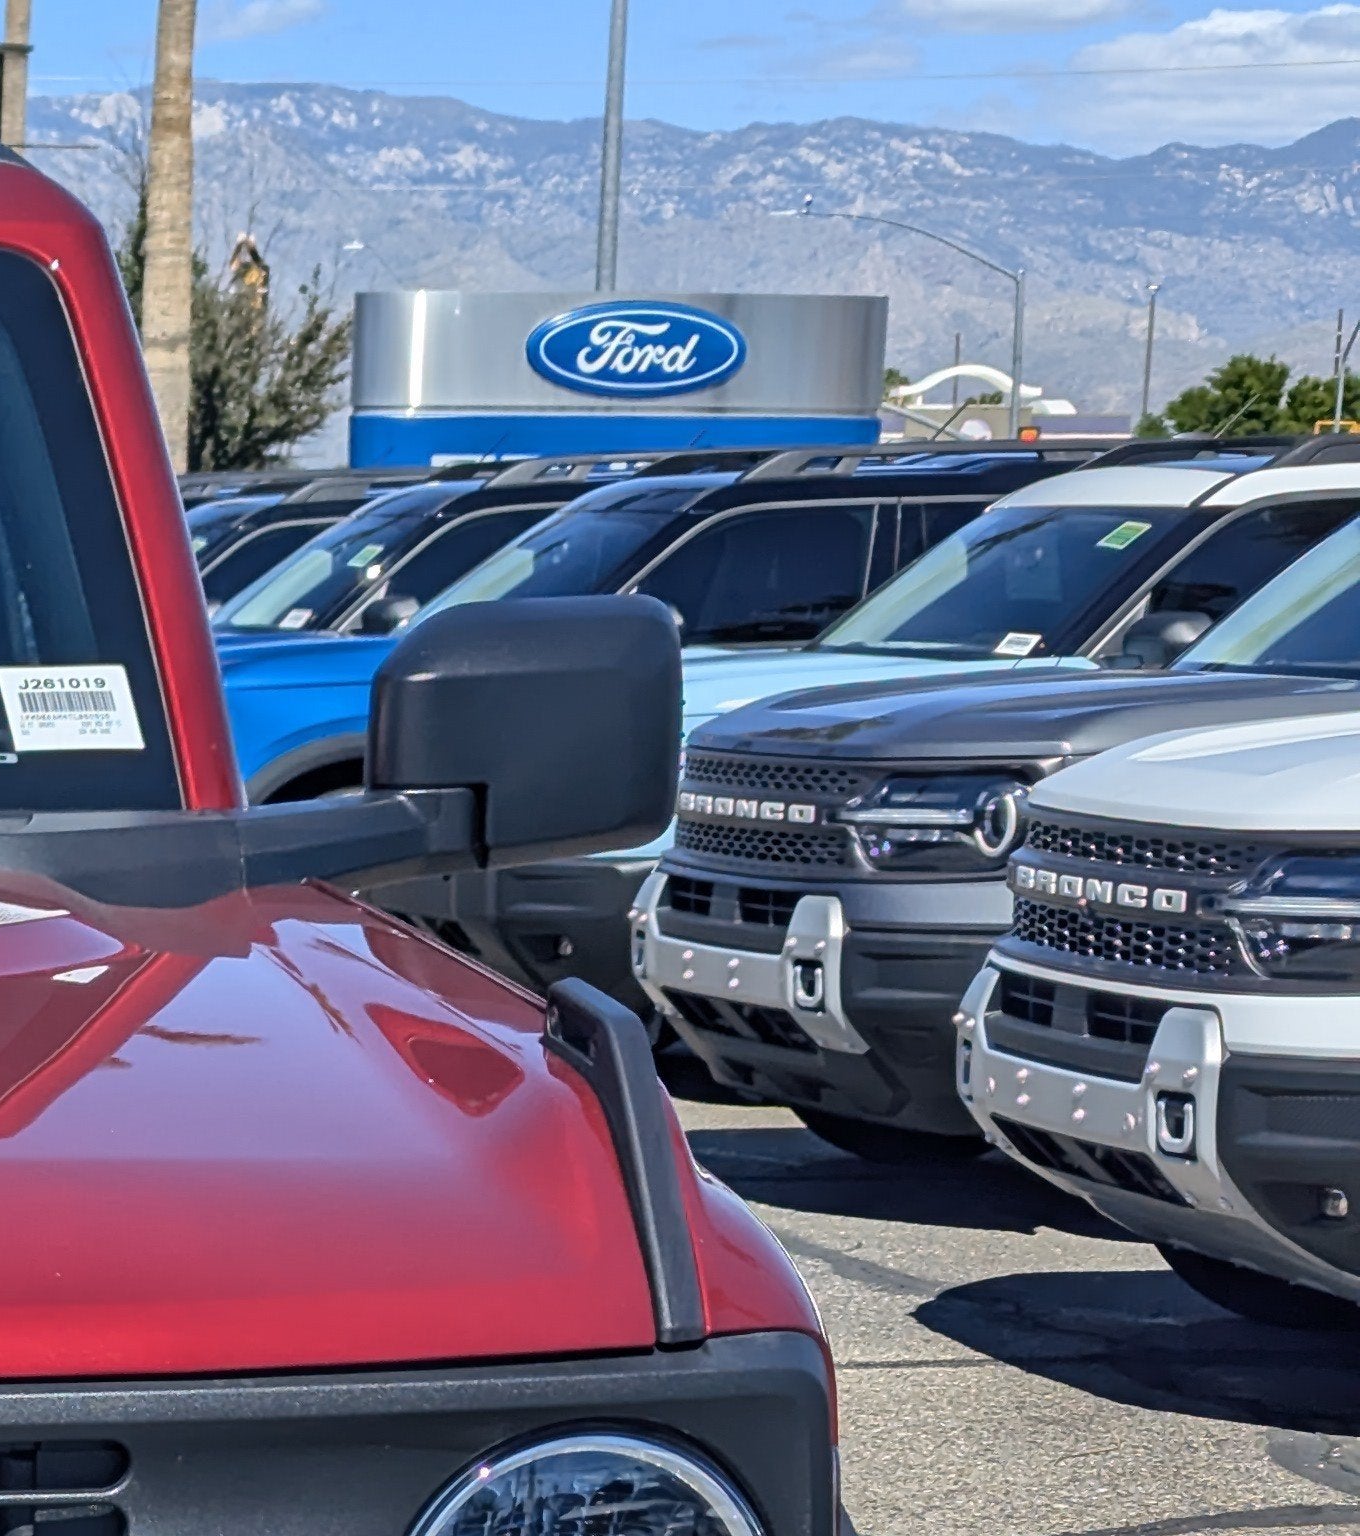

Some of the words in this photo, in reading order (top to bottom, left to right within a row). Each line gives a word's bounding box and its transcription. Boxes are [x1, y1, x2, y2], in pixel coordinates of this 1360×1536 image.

[577, 320, 700, 374] Ford
[18, 678, 106, 690] J261019
[680, 792, 816, 823] BRONCO
[1016, 865, 1187, 913] BRONCO
